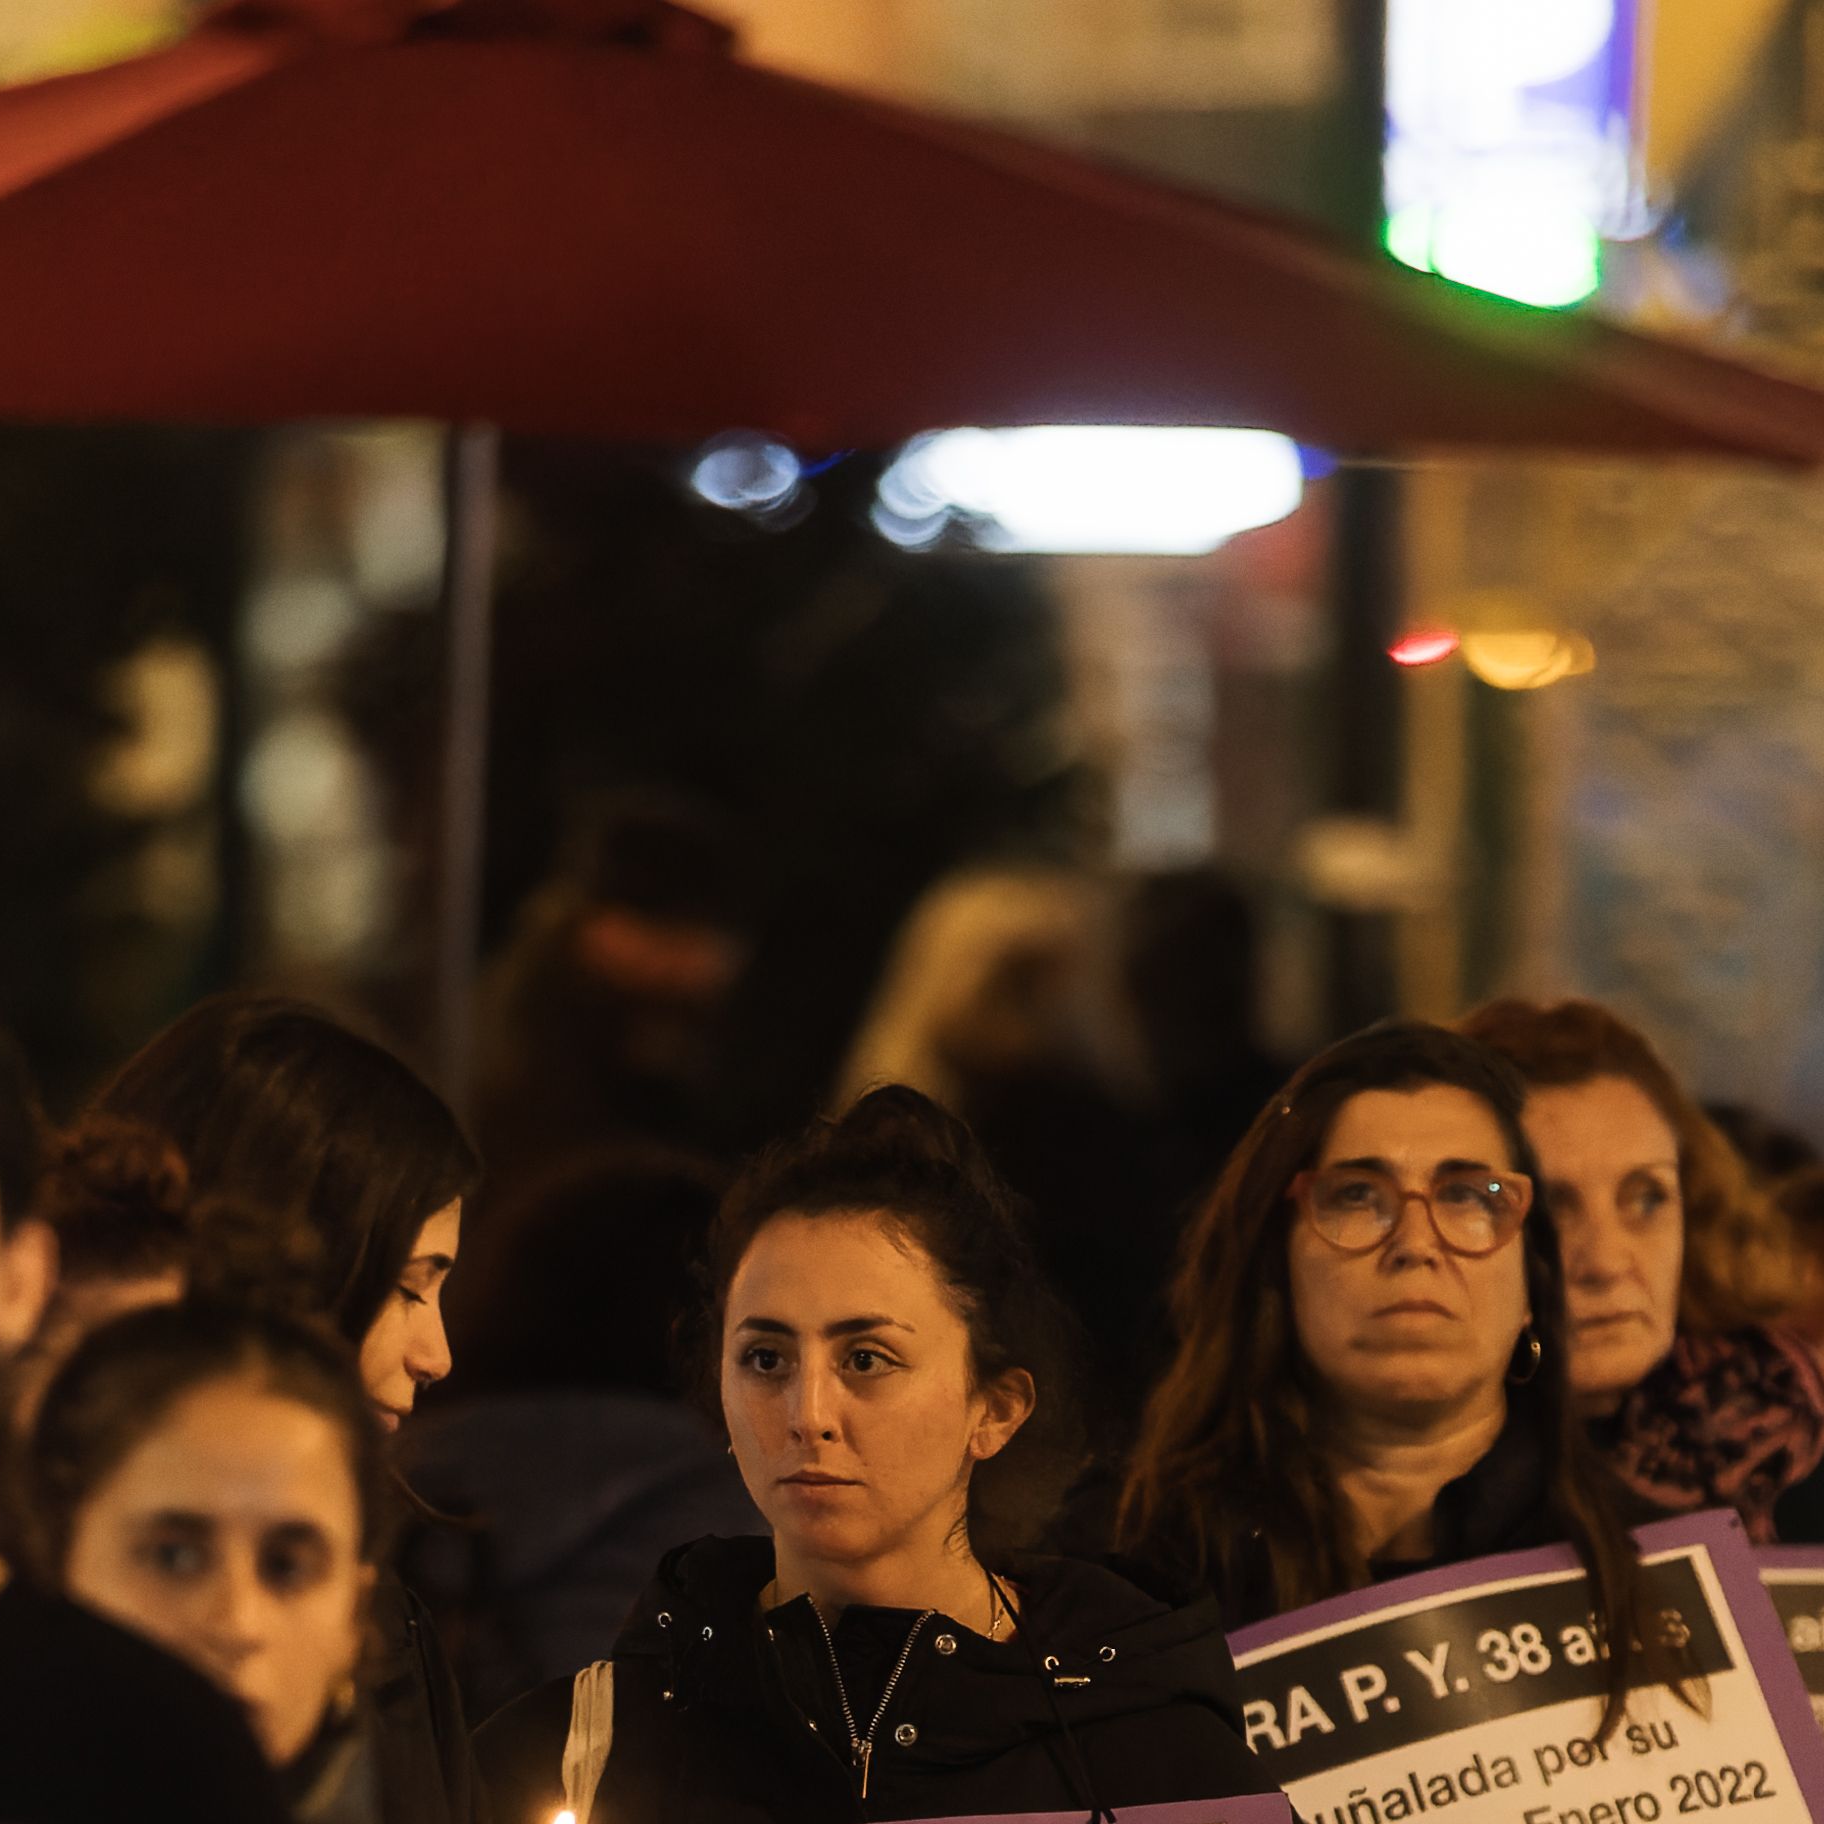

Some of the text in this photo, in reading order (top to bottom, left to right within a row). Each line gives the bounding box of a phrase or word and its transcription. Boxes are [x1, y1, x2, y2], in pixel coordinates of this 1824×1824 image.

[1340, 1663, 1401, 1723] P.
[1403, 1641, 1470, 1698] Y.
[1478, 1623, 1552, 1682] 38
[1534, 1736, 1609, 1787] por
[1626, 1721, 1679, 1754] su
[1669, 1761, 1776, 1814] 2022
